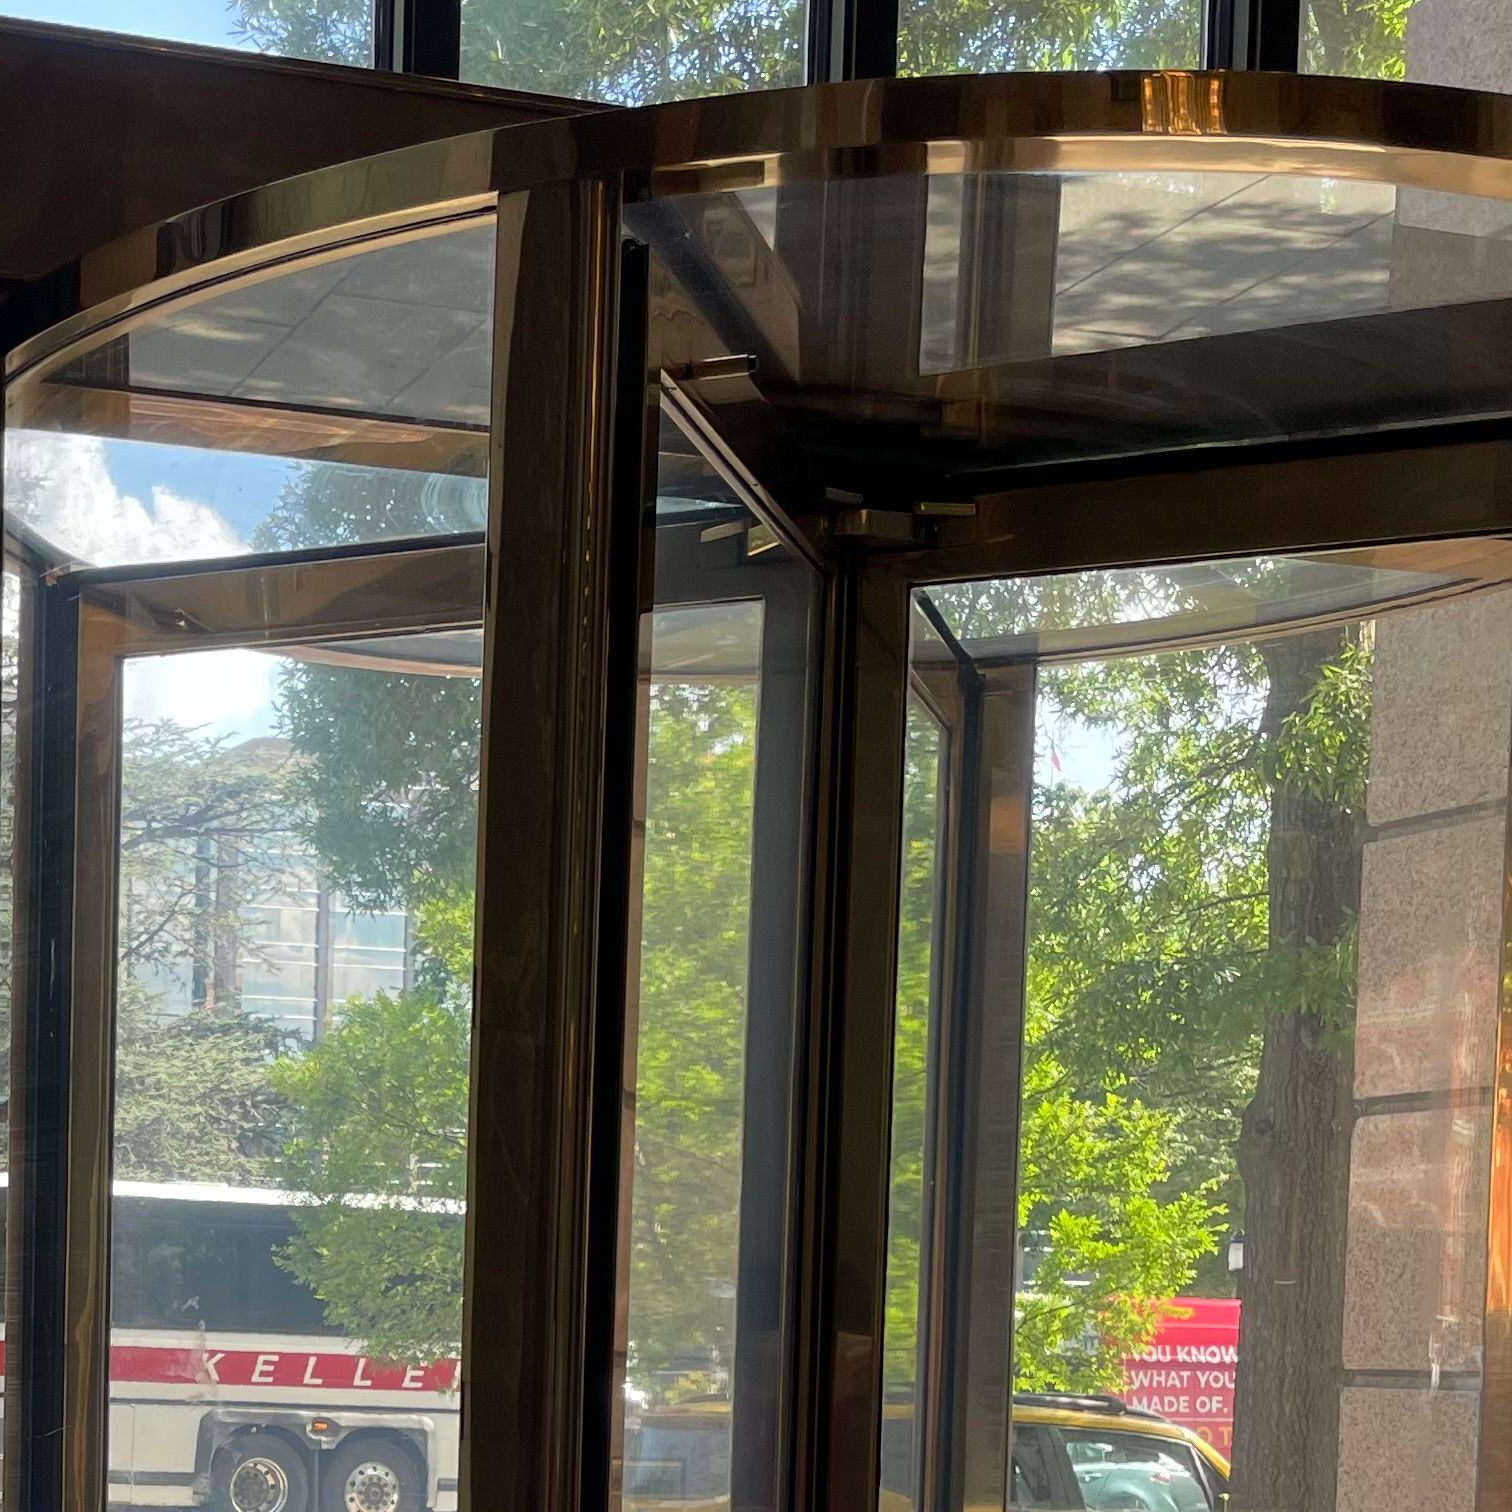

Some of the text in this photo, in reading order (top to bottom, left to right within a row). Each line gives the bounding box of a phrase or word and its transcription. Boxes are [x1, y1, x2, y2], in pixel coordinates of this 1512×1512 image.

[1175, 1345, 1238, 1364] KNOW
[197, 1352, 462, 1390] KELLE
[1130, 1370, 1191, 1388] WHAT
[1131, 1395, 1228, 1413] MADE OF.
